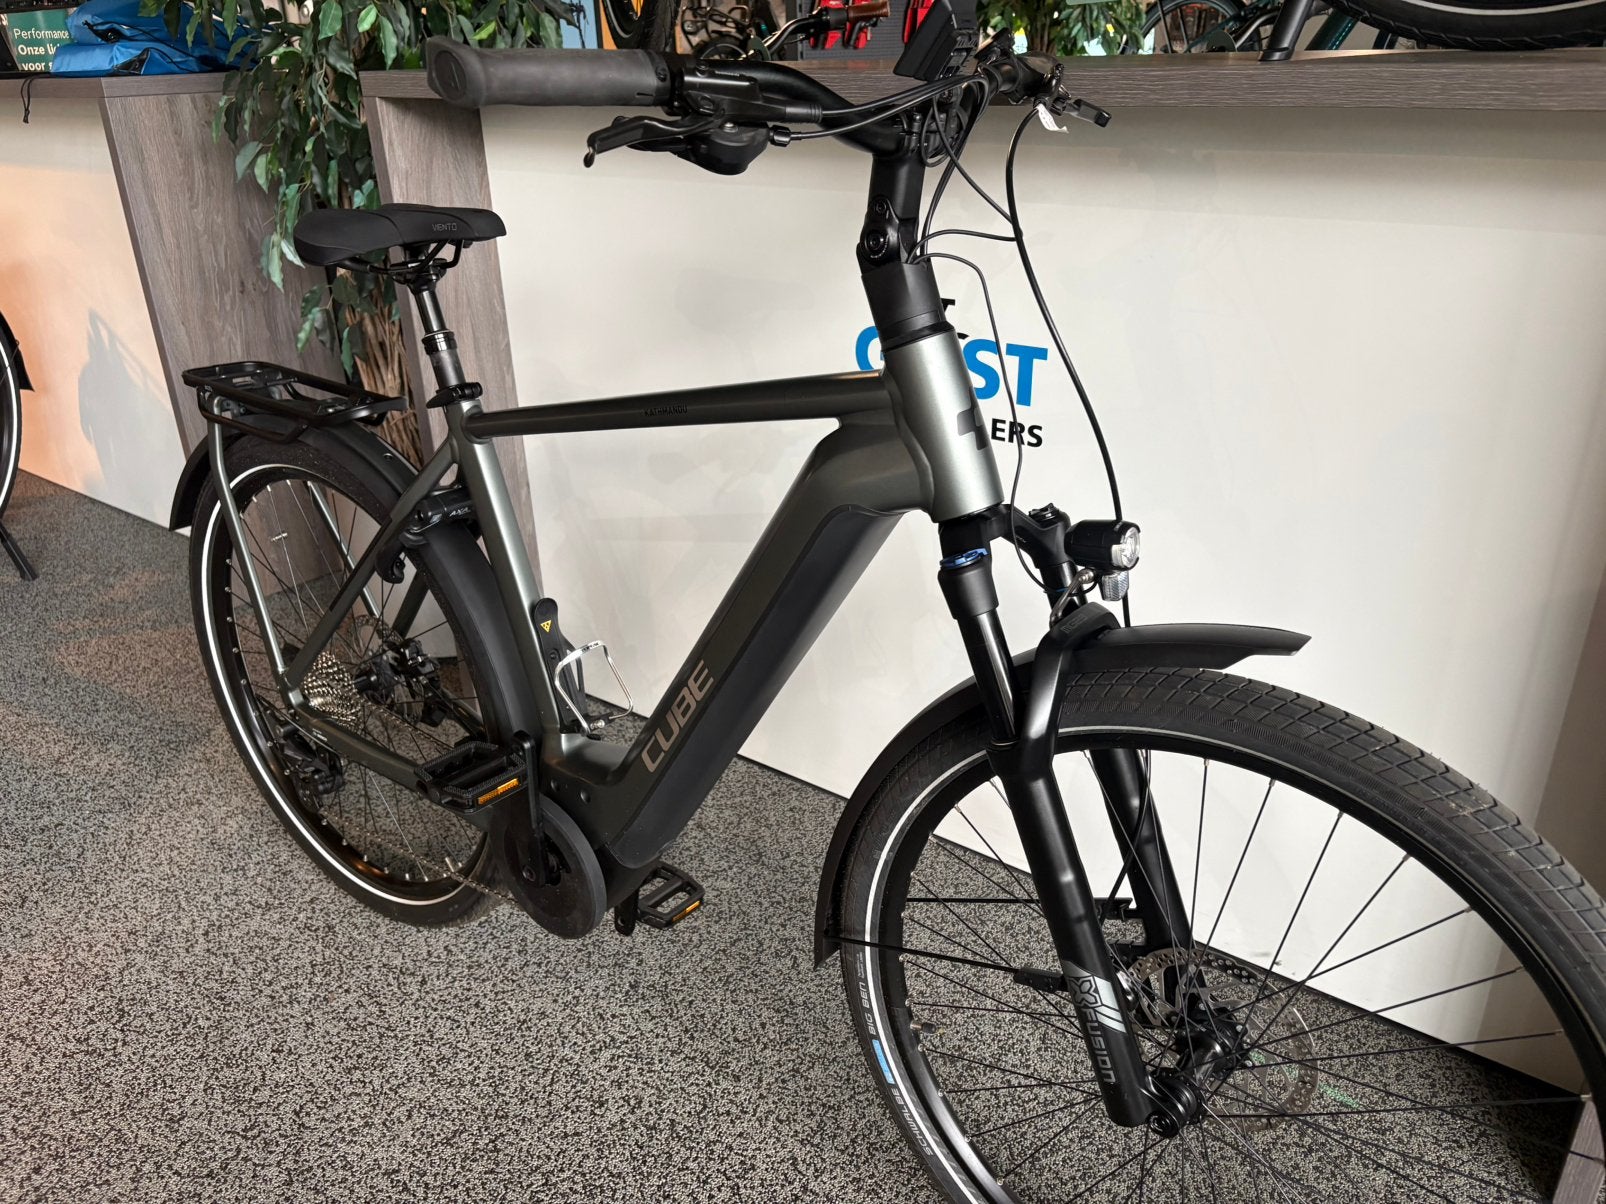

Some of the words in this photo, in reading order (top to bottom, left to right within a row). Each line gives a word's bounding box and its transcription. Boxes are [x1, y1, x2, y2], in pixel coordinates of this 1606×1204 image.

[13, 28, 70, 39] Performance
[18, 44, 45, 55] Onze
[22, 62, 45, 71] voor
[644, 404, 688, 417] KATHMANDU
[641, 660, 714, 773] CUBE
[859, 981, 870, 1009] BEN
[865, 1012, 877, 1036] BIG
[891, 1088, 934, 1156] SCHWALBE
